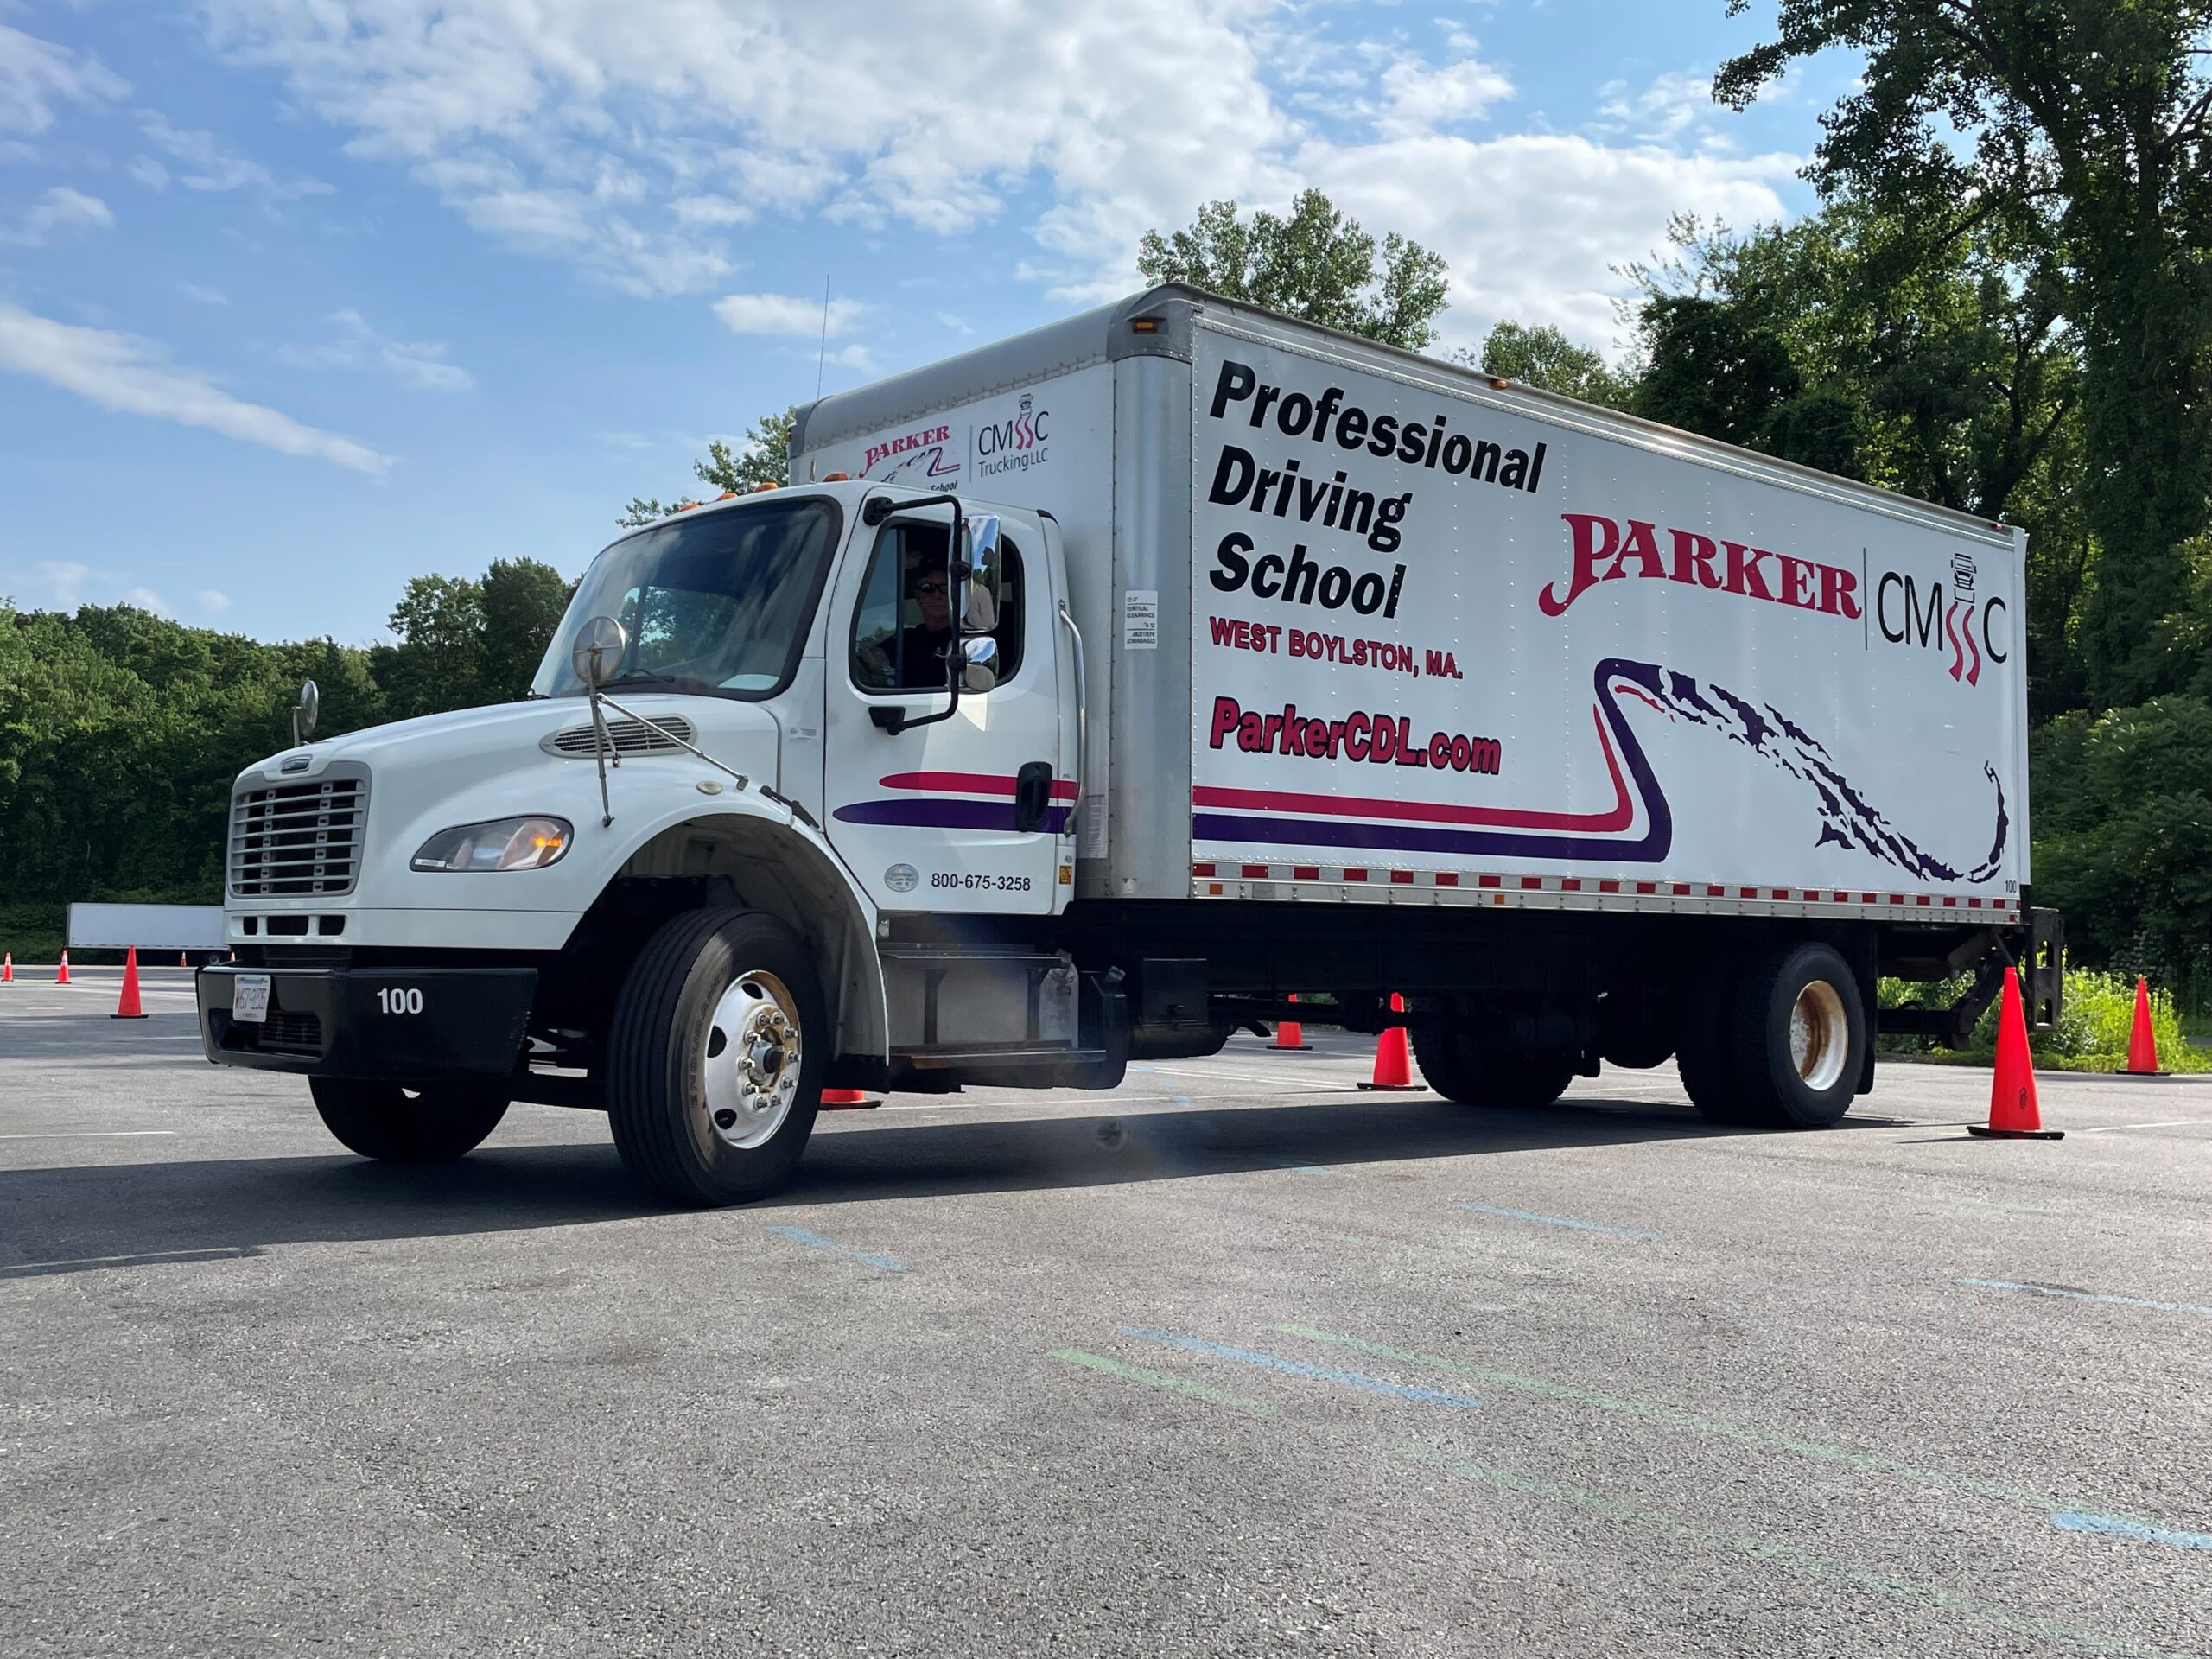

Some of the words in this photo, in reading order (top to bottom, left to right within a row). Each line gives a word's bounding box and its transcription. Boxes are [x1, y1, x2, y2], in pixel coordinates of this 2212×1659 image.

[859, 425, 951, 479] PARKER
[1209, 360, 1548, 493] Professional
[978, 454, 1029, 478] Trucking
[1030, 448, 1049, 465] LLC
[1208, 445, 1414, 553] Driving
[1209, 531, 1407, 619] School
[1538, 513, 1862, 620] PARKER
[1210, 616, 1282, 654] WEST
[1288, 629, 1420, 677] BOYLSTON,
[1426, 649, 1464, 679] MA.
[1209, 696, 1503, 775] ParkerCDL.com
[931, 873, 1031, 891] 800-675-3258
[2005, 880, 2018, 893] 100
[377, 988, 423, 1014] 100
